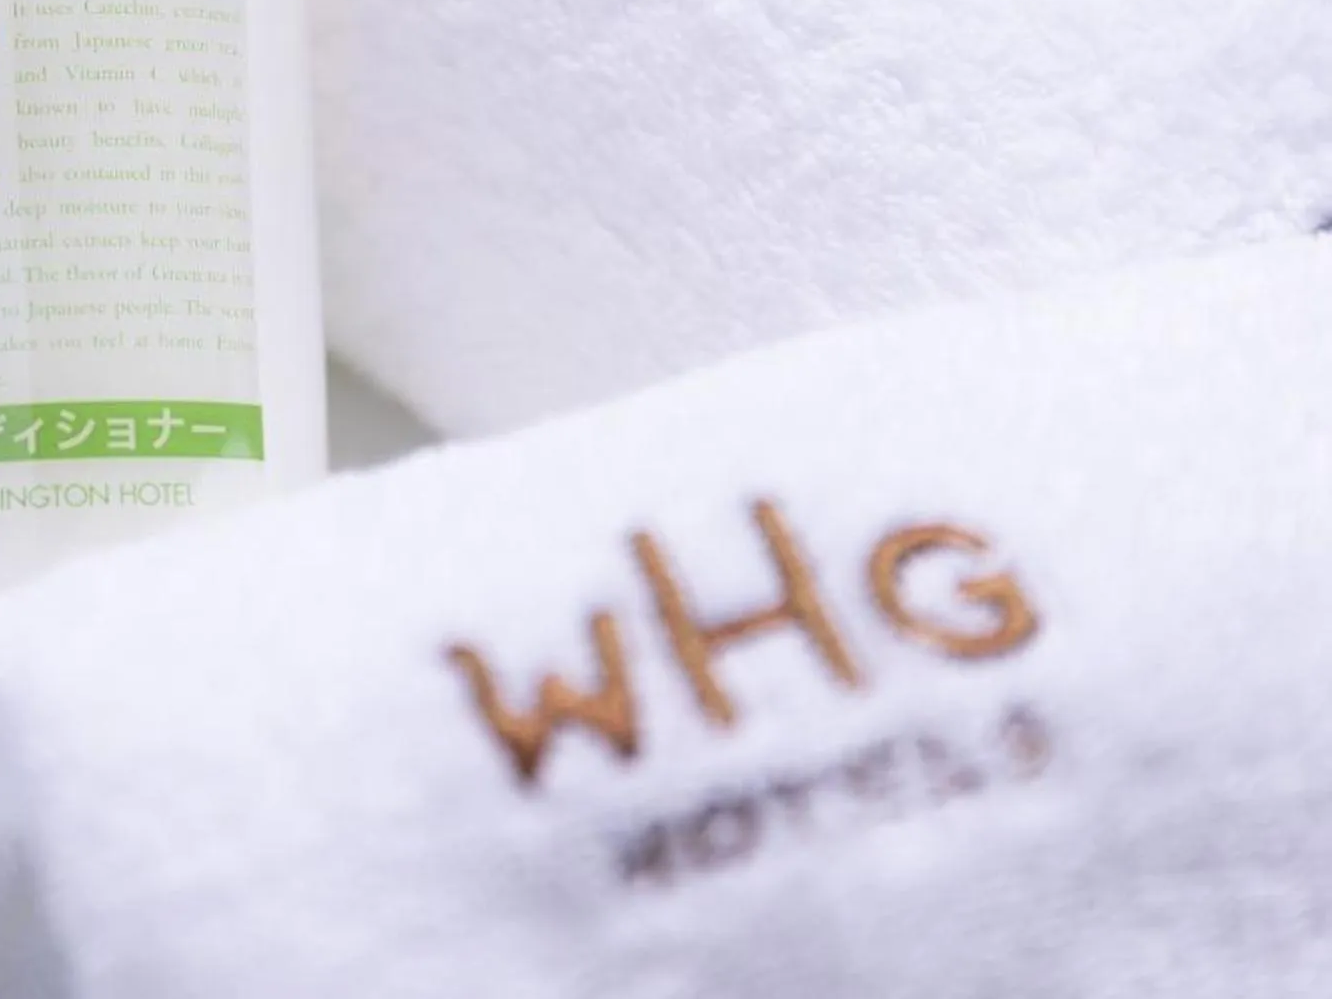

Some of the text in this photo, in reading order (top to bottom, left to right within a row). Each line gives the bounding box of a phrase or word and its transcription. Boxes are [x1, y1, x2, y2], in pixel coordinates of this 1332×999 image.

[14, 32, 60, 52] from
[73, 30, 153, 54] Japanese
[14, 65, 47, 83] and
[65, 63, 135, 82] Vitamin
[16, 97, 78, 116] known
[62, 163, 151, 182] contained
[3, 199, 47, 221] deep
[59, 199, 140, 216] moisture
[23, 264, 59, 285] The
[25, 300, 106, 324] Japanese
[119, 480, 194, 508] HOTEL
[448, 497, 1040, 789] WHG
